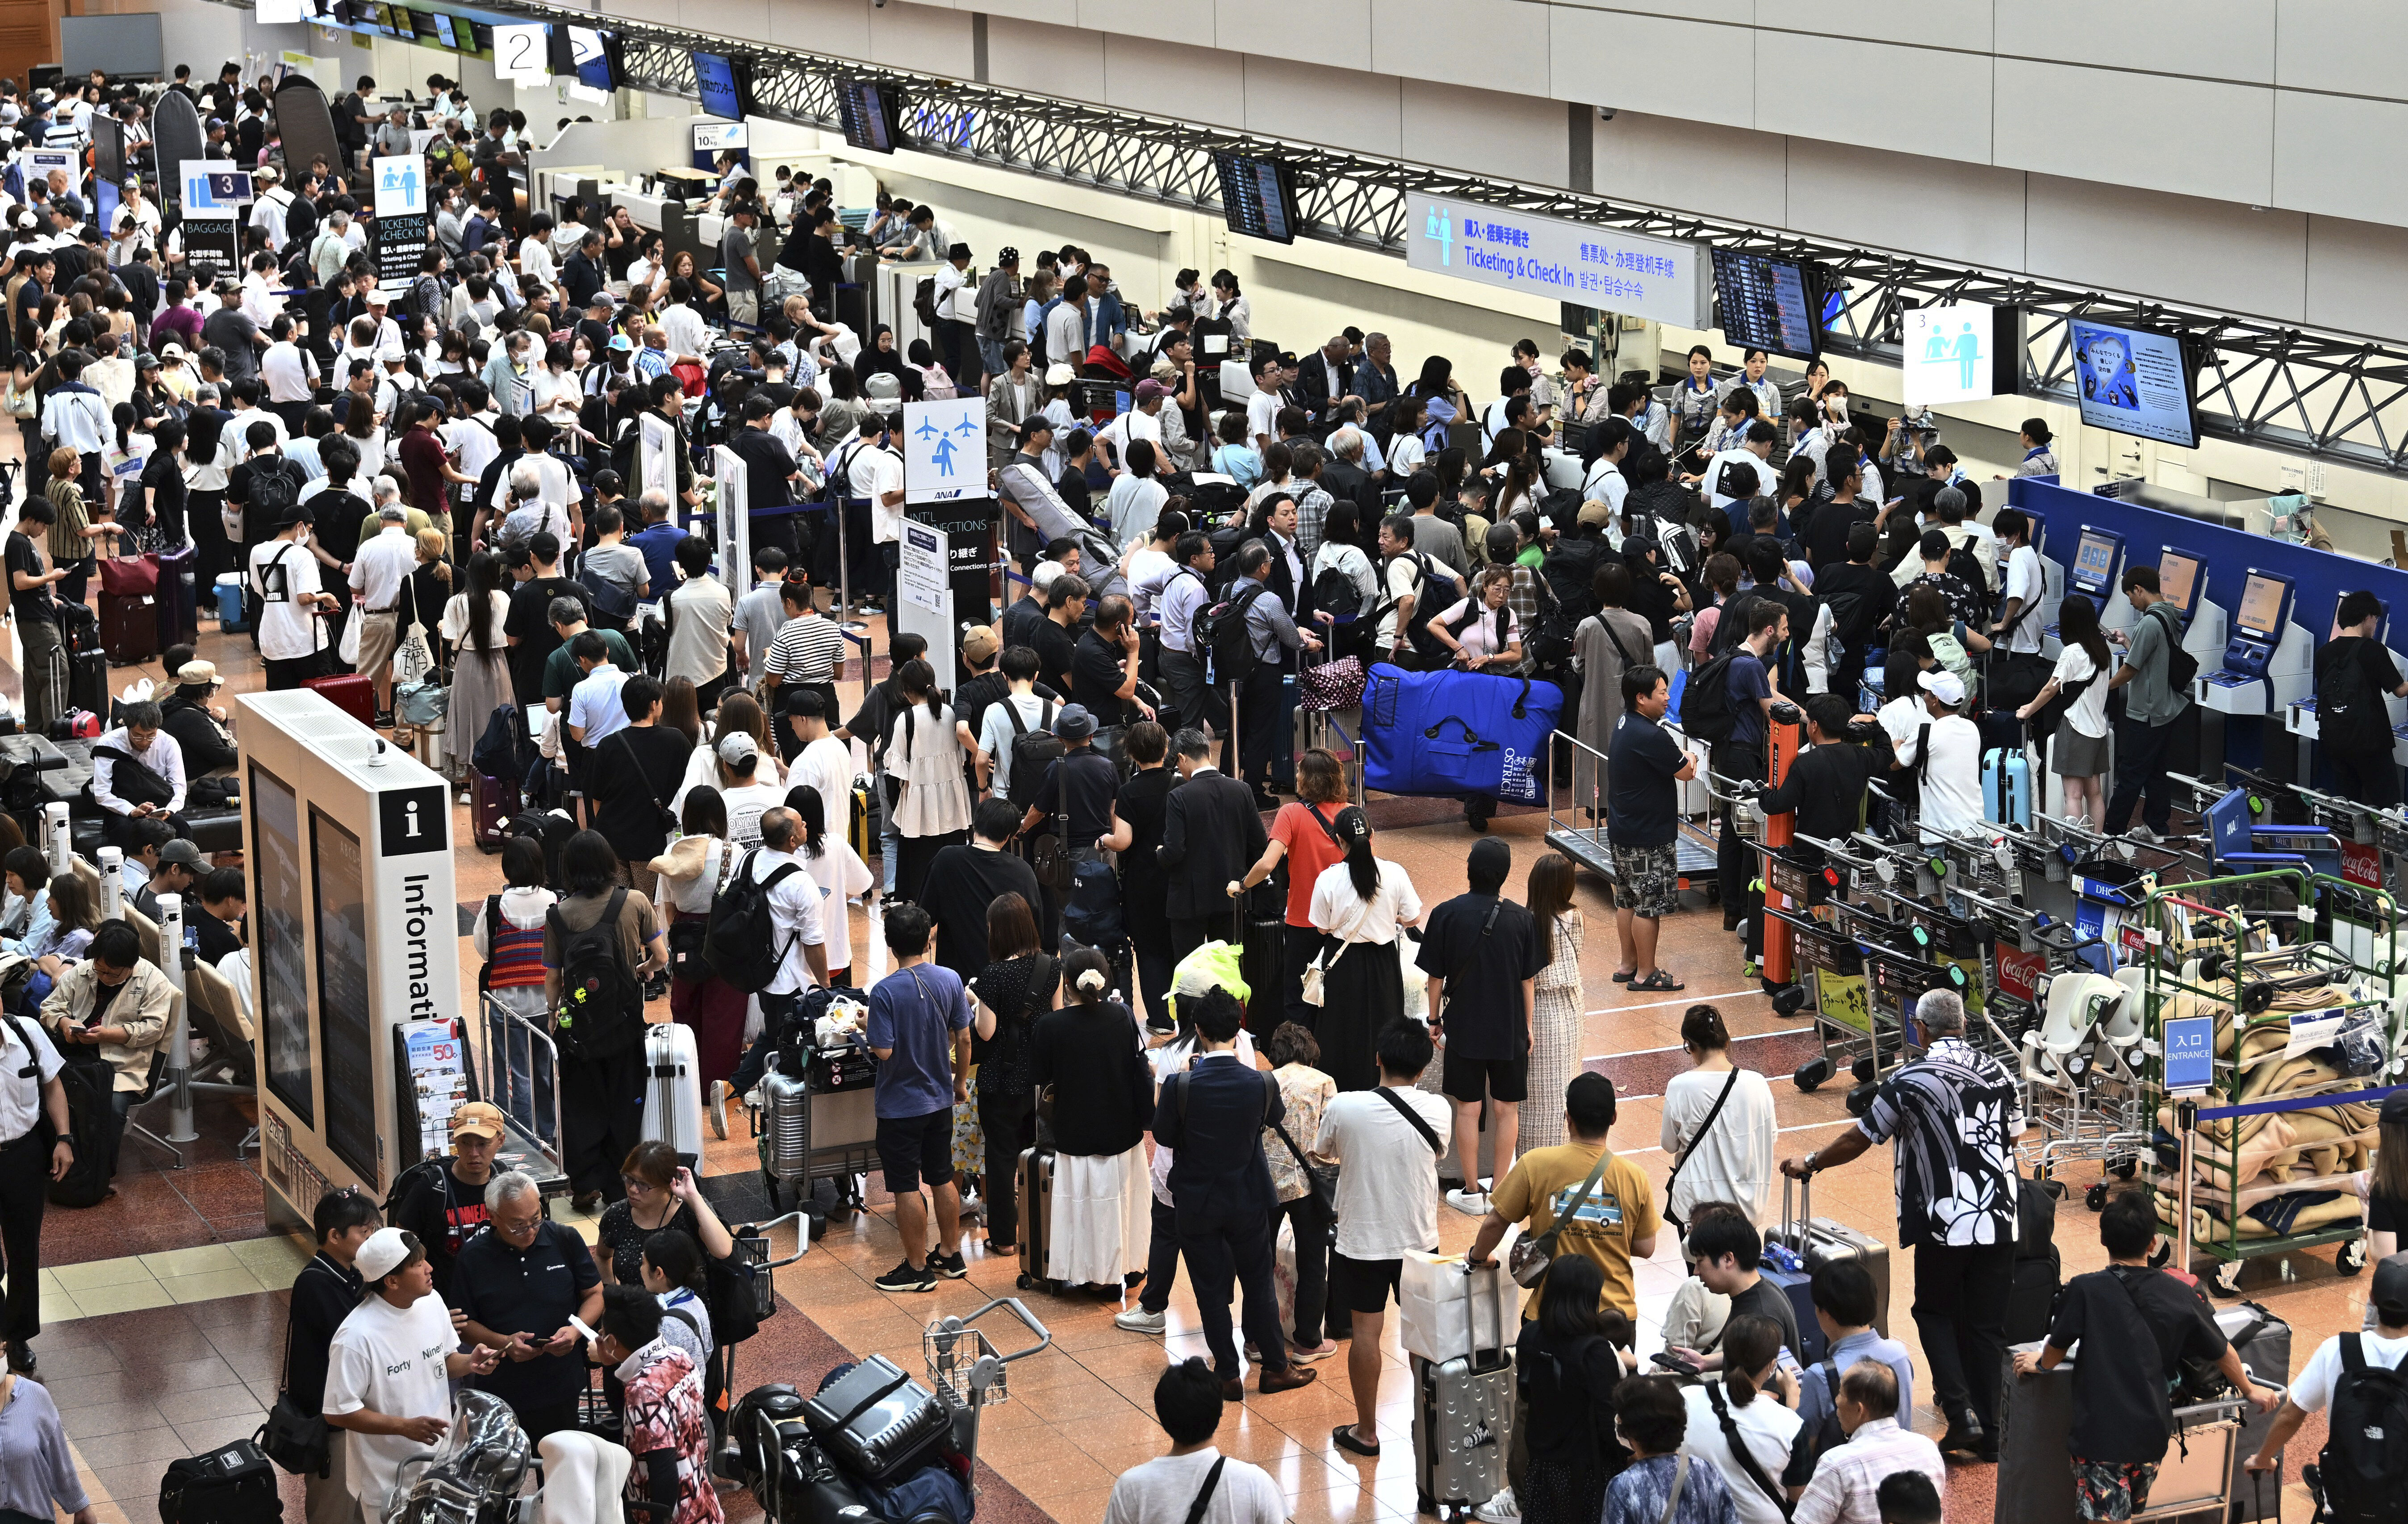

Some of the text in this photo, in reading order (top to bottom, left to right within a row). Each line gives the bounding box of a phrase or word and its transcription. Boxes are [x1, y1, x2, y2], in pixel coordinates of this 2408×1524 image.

[510, 34, 532, 69] 2
[697, 61, 710, 74] 9/12
[698, 137, 709, 146] 10
[222, 176, 233, 193] 3
[380, 217, 424, 230] TICKETING
[416, 228, 425, 237] IN
[1464, 218, 1530, 249] 購入・搭乗手続き
[1464, 245, 1575, 288] Ticketing & Check In
[1580, 242, 1675, 279] 售票处・办理登机手续
[1580, 271, 1644, 302] 발권・탑승수속
[1919, 314, 1926, 328] 3
[2090, 348, 2120, 359] みんなでつくる
[934, 491, 952, 500] ANA
[950, 563, 987, 572] Connections
[1501, 748, 1515, 795] OSTRICH
[2226, 820, 2235, 837] ANA
[2096, 885, 2114, 898] DHC
[2080, 922, 2099, 936] DHC
[404, 874, 437, 1021] Informati
[2176, 1034, 2201, 1047] 入口
[433, 1044, 454, 1061] 50
[2167, 1049, 2210, 1061] ENTRANCE
[639, 1343, 662, 1361] KARL
[387, 1360, 410, 1376] Forty
